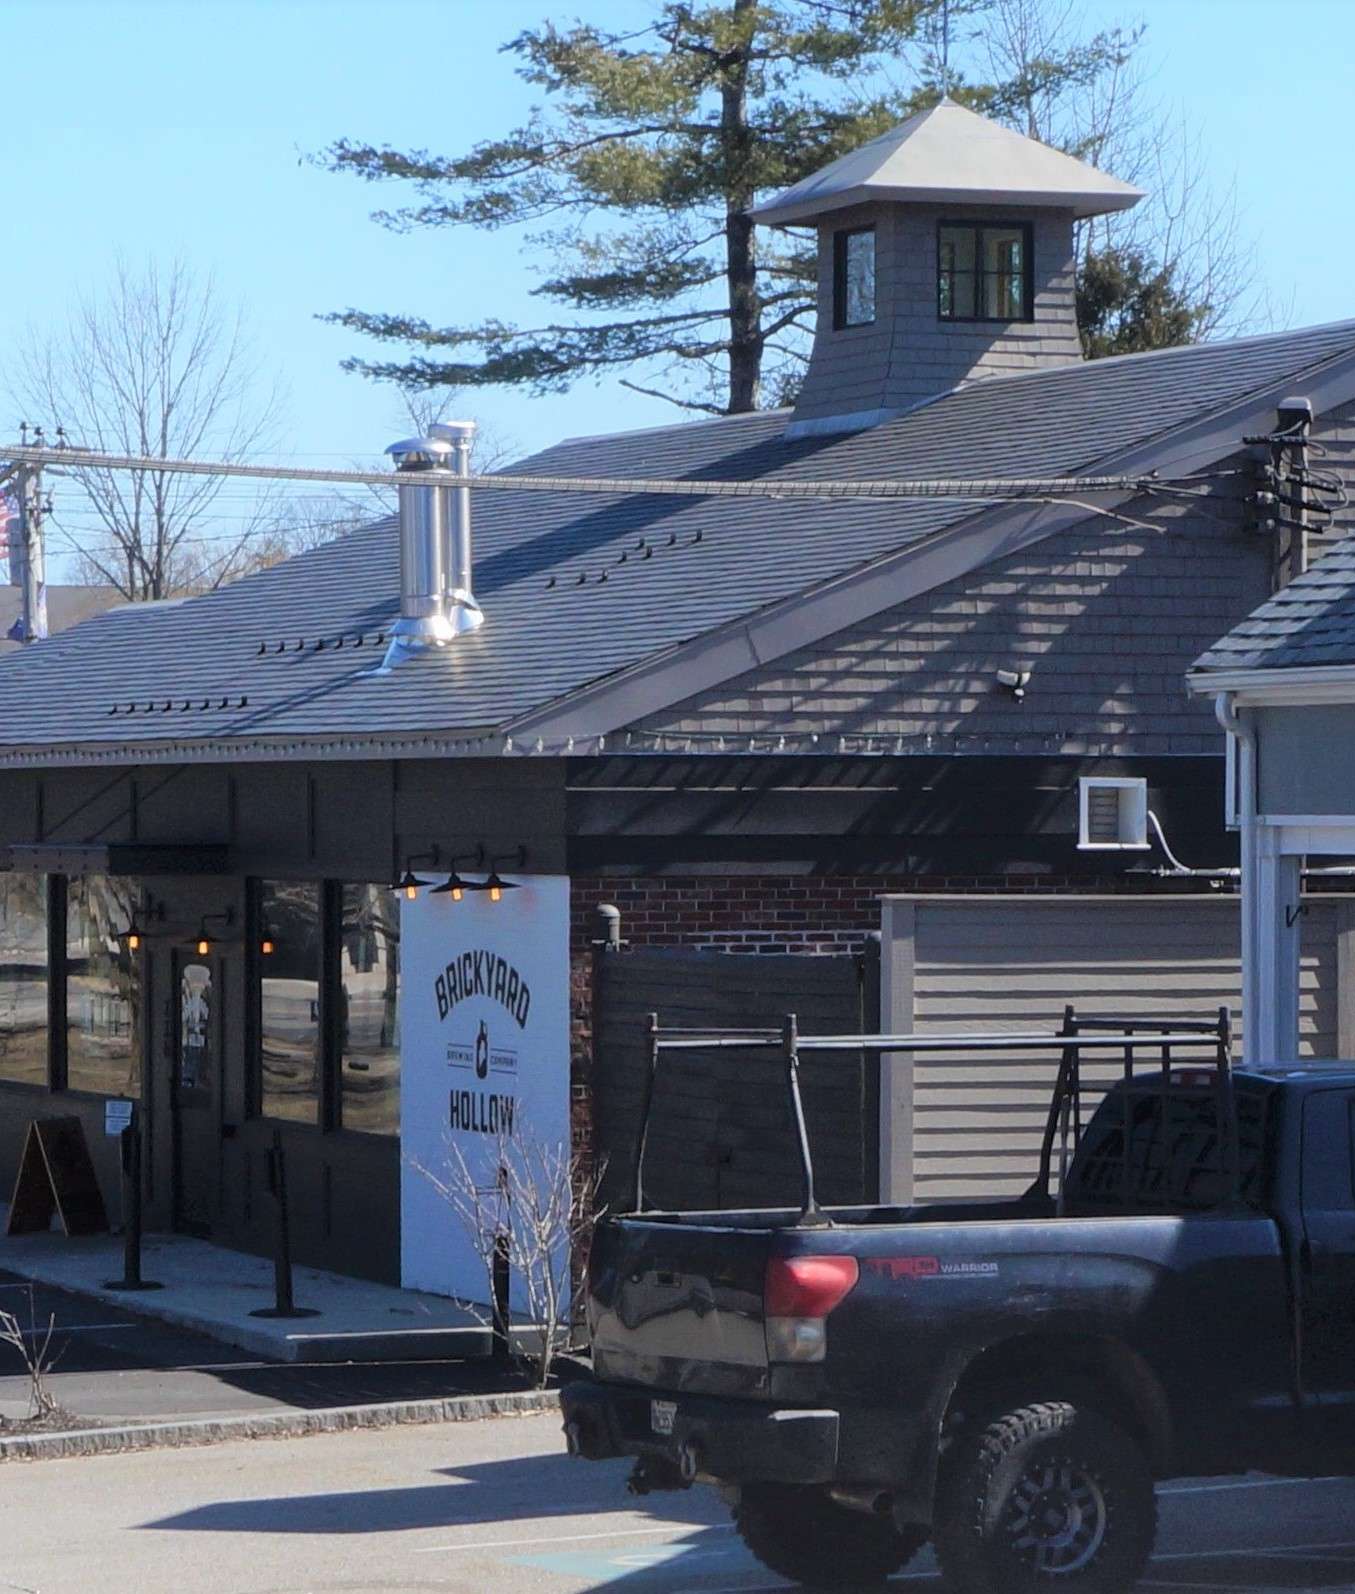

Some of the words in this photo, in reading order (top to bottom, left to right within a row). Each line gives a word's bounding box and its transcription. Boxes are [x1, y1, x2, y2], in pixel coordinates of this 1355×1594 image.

[435, 949, 530, 1029] BRICKYARD
[450, 1089, 514, 1136] HOLLOW
[940, 1262, 999, 1274] WARRIOR
